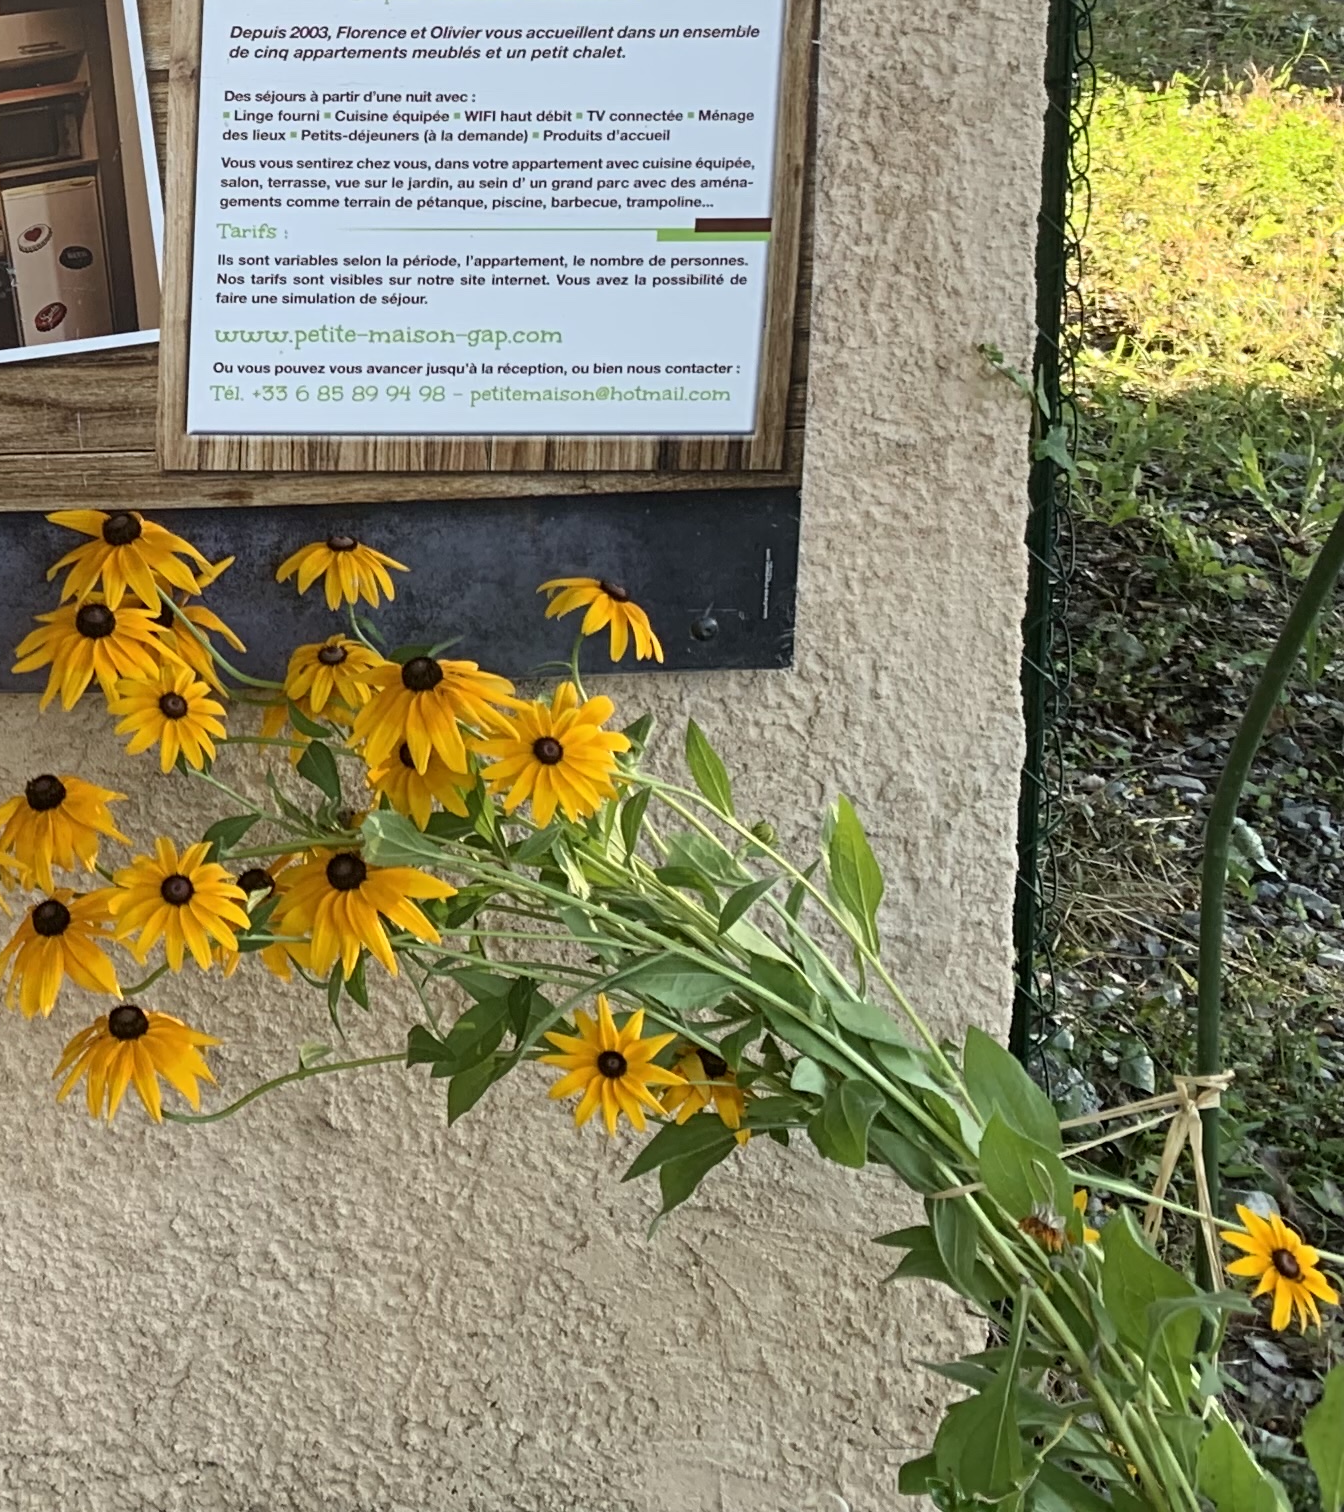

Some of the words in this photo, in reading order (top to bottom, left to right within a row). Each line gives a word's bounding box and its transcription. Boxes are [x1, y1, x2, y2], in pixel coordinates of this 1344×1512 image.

[230, 26, 287, 41] Depuis
[289, 26, 331, 41] 2003,
[336, 26, 407, 39] Florence
[410, 26, 427, 39] et
[430, 26, 483, 39] Olivier
[485, 29, 523, 39] vous
[526, 26, 614, 39] accueillent
[617, 25, 656, 39] dans
[659, 28, 679, 38] un
[683, 25, 760, 38] ensemble
[229, 45, 250, 58] de
[254, 46, 289, 61] cinq
[293, 46, 408, 62] appartements
[412, 46, 481, 59] meublés
[485, 46, 502, 59] et
[506, 49, 527, 59] un
[530, 45, 569, 62] petit
[573, 45, 626, 59] chalet.
[224, 90, 251, 102] Des
[255, 90, 306, 104] séjours
[310, 90, 318, 102] à
[322, 91, 360, 105] partir
[363, 91, 402, 102] d'une
[406, 91, 432, 102] nuit
[435, 93, 468, 103] avec
[234, 110, 273, 124] Linge
[278, 110, 320, 122] fourni
[335, 110, 388, 122] Cuisine
[392, 110, 450, 124] équipée
[464, 110, 496, 122] WIFI
[500, 110, 532, 122] haut
[536, 110, 572, 122] débit
[586, 110, 606, 122] TV
[609, 110, 683, 122] connectée
[698, 109, 754, 124] Ménage
[222, 129, 248, 141] des
[253, 129, 286, 141] lieux
[301, 129, 419, 144] Petits-déjeuners
[424, 129, 437, 144] (à
[441, 130, 453, 141] la
[457, 129, 528, 144] demande)
[543, 130, 602, 141] Produits
[606, 129, 670, 141] d'accueil
[221, 157, 256, 169] Vous
[259, 160, 293, 169] vous
[296, 158, 353, 169] sentirez
[356, 157, 390, 169] chez
[393, 160, 431, 171] vous,
[435, 158, 469, 169] dans
[472, 158, 509, 169] votre
[512, 158, 603, 172] appartement
[606, 160, 639, 169] avec
[642, 157, 692, 169] cuisine
[695, 157, 755, 171] équipée,
[220, 176, 263, 190] salon,
[267, 177, 330, 190] terrasse,
[335, 179, 360, 188] vue
[364, 179, 388, 188] sur
[392, 177, 404, 189] le
[407, 177, 453, 191] jardin,
[457, 180, 475, 189] au
[479, 177, 508, 189] sein
[530, 180, 547, 189] un
[551, 177, 593, 191] grand
[597, 180, 629, 191] parc
[633, 179, 667, 188] avec
[670, 177, 696, 188] des
[700, 176, 754, 188] aména-
[220, 196, 282, 210] gements
[286, 198, 340, 208] comme
[344, 196, 391, 208] terrain
[395, 196, 413, 208] de
[417, 196, 487, 210] pétanque,
[492, 196, 547, 210] piscine,
[551, 196, 622, 209] barbecue,
[626, 196, 714, 210] trampoline...
[216, 223, 277, 239] Tarifs
[218, 254, 234, 266] Ils
[238, 255, 270, 266] sont
[274, 254, 338, 266] variables
[343, 255, 381, 266] selon
[386, 255, 398, 266] la
[403, 255, 461, 269] période,
[466, 255, 568, 269] l'appartement,
[573, 255, 585, 266] le
[590, 255, 644, 267] nombre
[648, 255, 666, 266] de
[670, 257, 748, 269] personnes.
[217, 273, 245, 285] Nos
[251, 273, 287, 285] tarifs
[293, 274, 324, 285] sont
[330, 274, 383, 285] visibles
[389, 277, 412, 285] sur
[417, 275, 455, 285] notre
[460, 274, 486, 286] site
[492, 274, 550, 286] internet.
[556, 274, 591, 286] Vous
[596, 277, 629, 285] avez
[634, 274, 647, 285] la
[652, 273, 724, 288] possibilité
[730, 273, 747, 285] de
[216, 292, 247, 304] faire
[251, 295, 278, 304] une
[282, 292, 355, 304] simulation
[359, 293, 377, 304] de
[381, 293, 428, 307] séjour.
[215, 324, 563, 350] www.petite-maison-gap.com
[213, 362, 233, 373] Ou
[237, 365, 271, 374] vous
[274, 365, 325, 376] pouvez
[329, 365, 362, 374] vous
[366, 365, 423, 374] avancer
[425, 363, 477, 377] jusqu'à
[481, 363, 493, 374] la
[497, 363, 567, 376] réception,
[571, 365, 589, 374] ou
[593, 363, 623, 374] bien
[627, 365, 661, 374] nous
[665, 363, 733, 374] contacter
[209, 385, 244, 401] Tél.
[252, 385, 288, 401] +33
[295, 385, 310, 402] 6
[317, 385, 344, 402] 85
[351, 385, 379, 402] 89
[386, 385, 411, 402] 94
[419, 385, 446, 402] 98
[470, 385, 731, 407] petitemaison@hotmail.com
